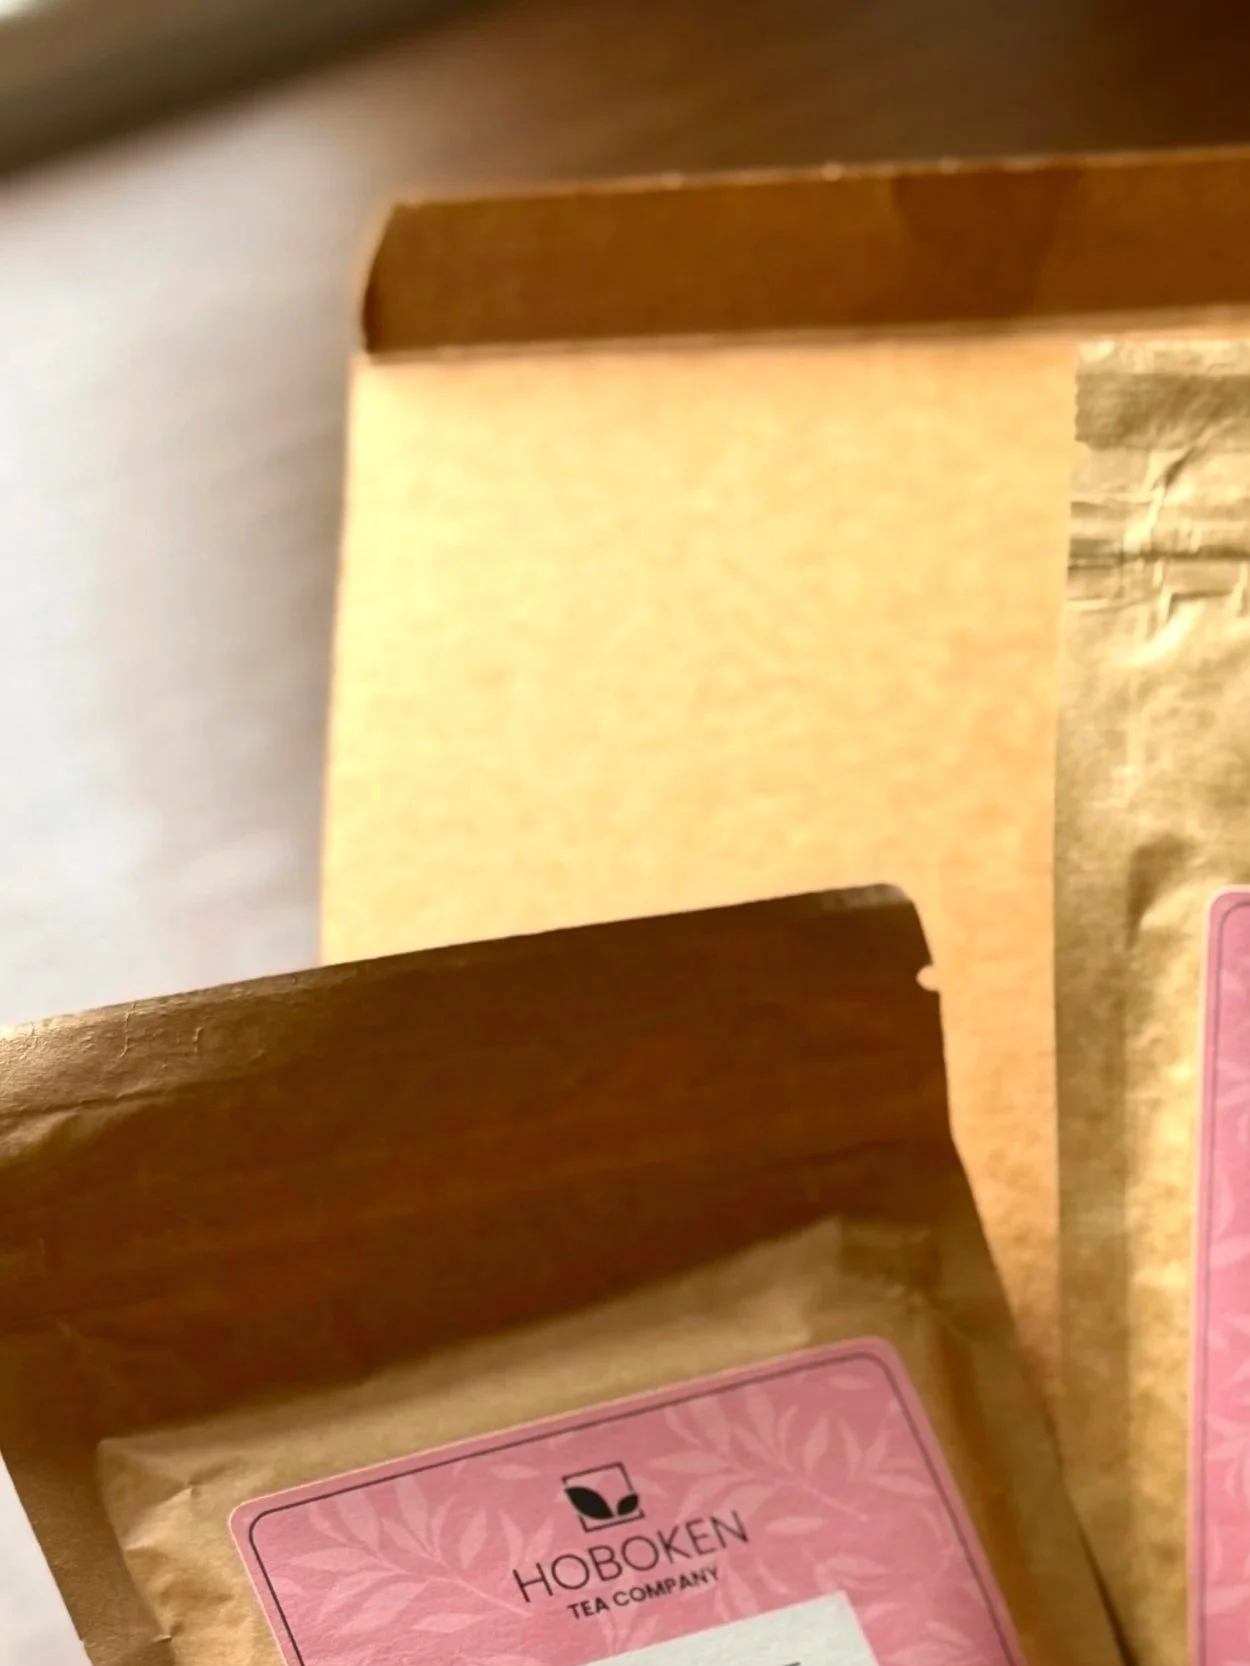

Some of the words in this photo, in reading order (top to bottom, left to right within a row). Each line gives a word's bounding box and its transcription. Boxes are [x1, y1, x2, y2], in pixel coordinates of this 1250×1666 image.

[512, 1510, 749, 1604] HOBOKEN
[567, 1597, 610, 1621] TEA
[612, 1566, 720, 1608] COMPANY
